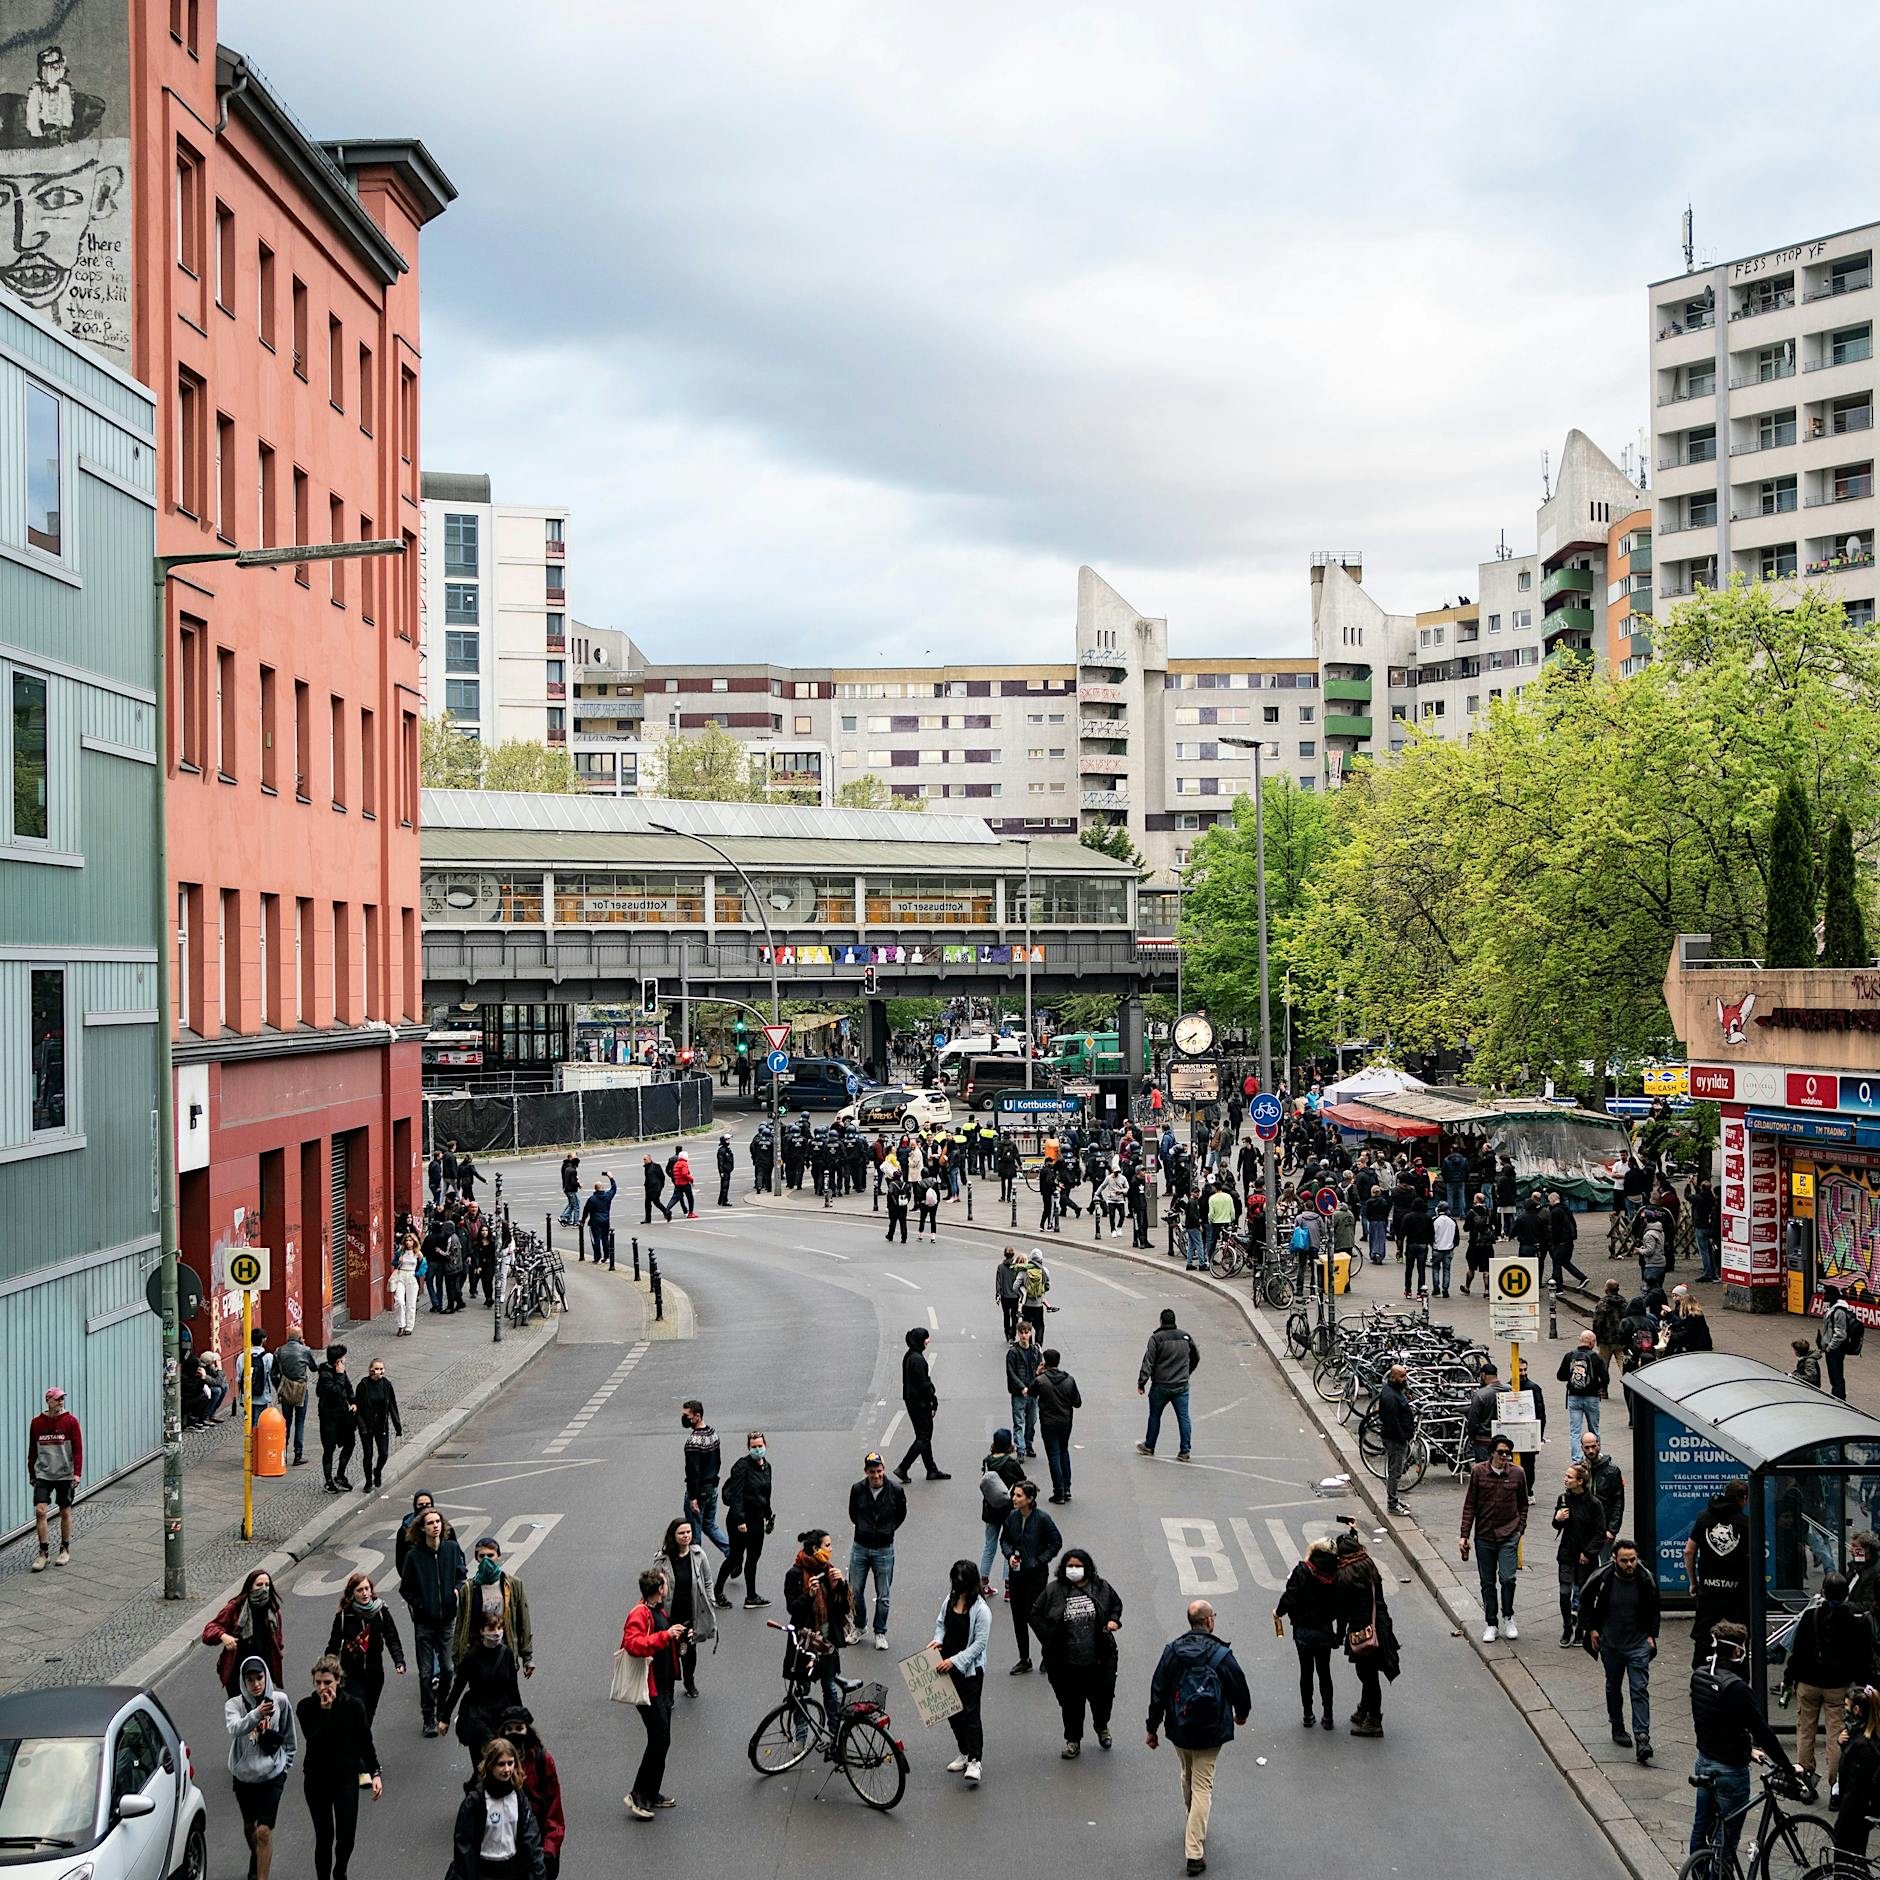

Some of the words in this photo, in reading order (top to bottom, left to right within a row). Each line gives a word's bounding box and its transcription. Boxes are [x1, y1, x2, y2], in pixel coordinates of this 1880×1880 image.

[1735, 257, 1767, 279] FESS
[1004, 1100, 1013, 1110] U
[1062, 1100, 1075, 1109] Tor
[1800, 1098, 1823, 1106] vodafone
[238, 1262, 253, 1278] H
[1507, 1273, 1523, 1290] H
[1659, 1451, 1691, 1463] UND
[1703, 1579, 1739, 1588] AMSTAFF
[907, 1655, 930, 1676] NO
